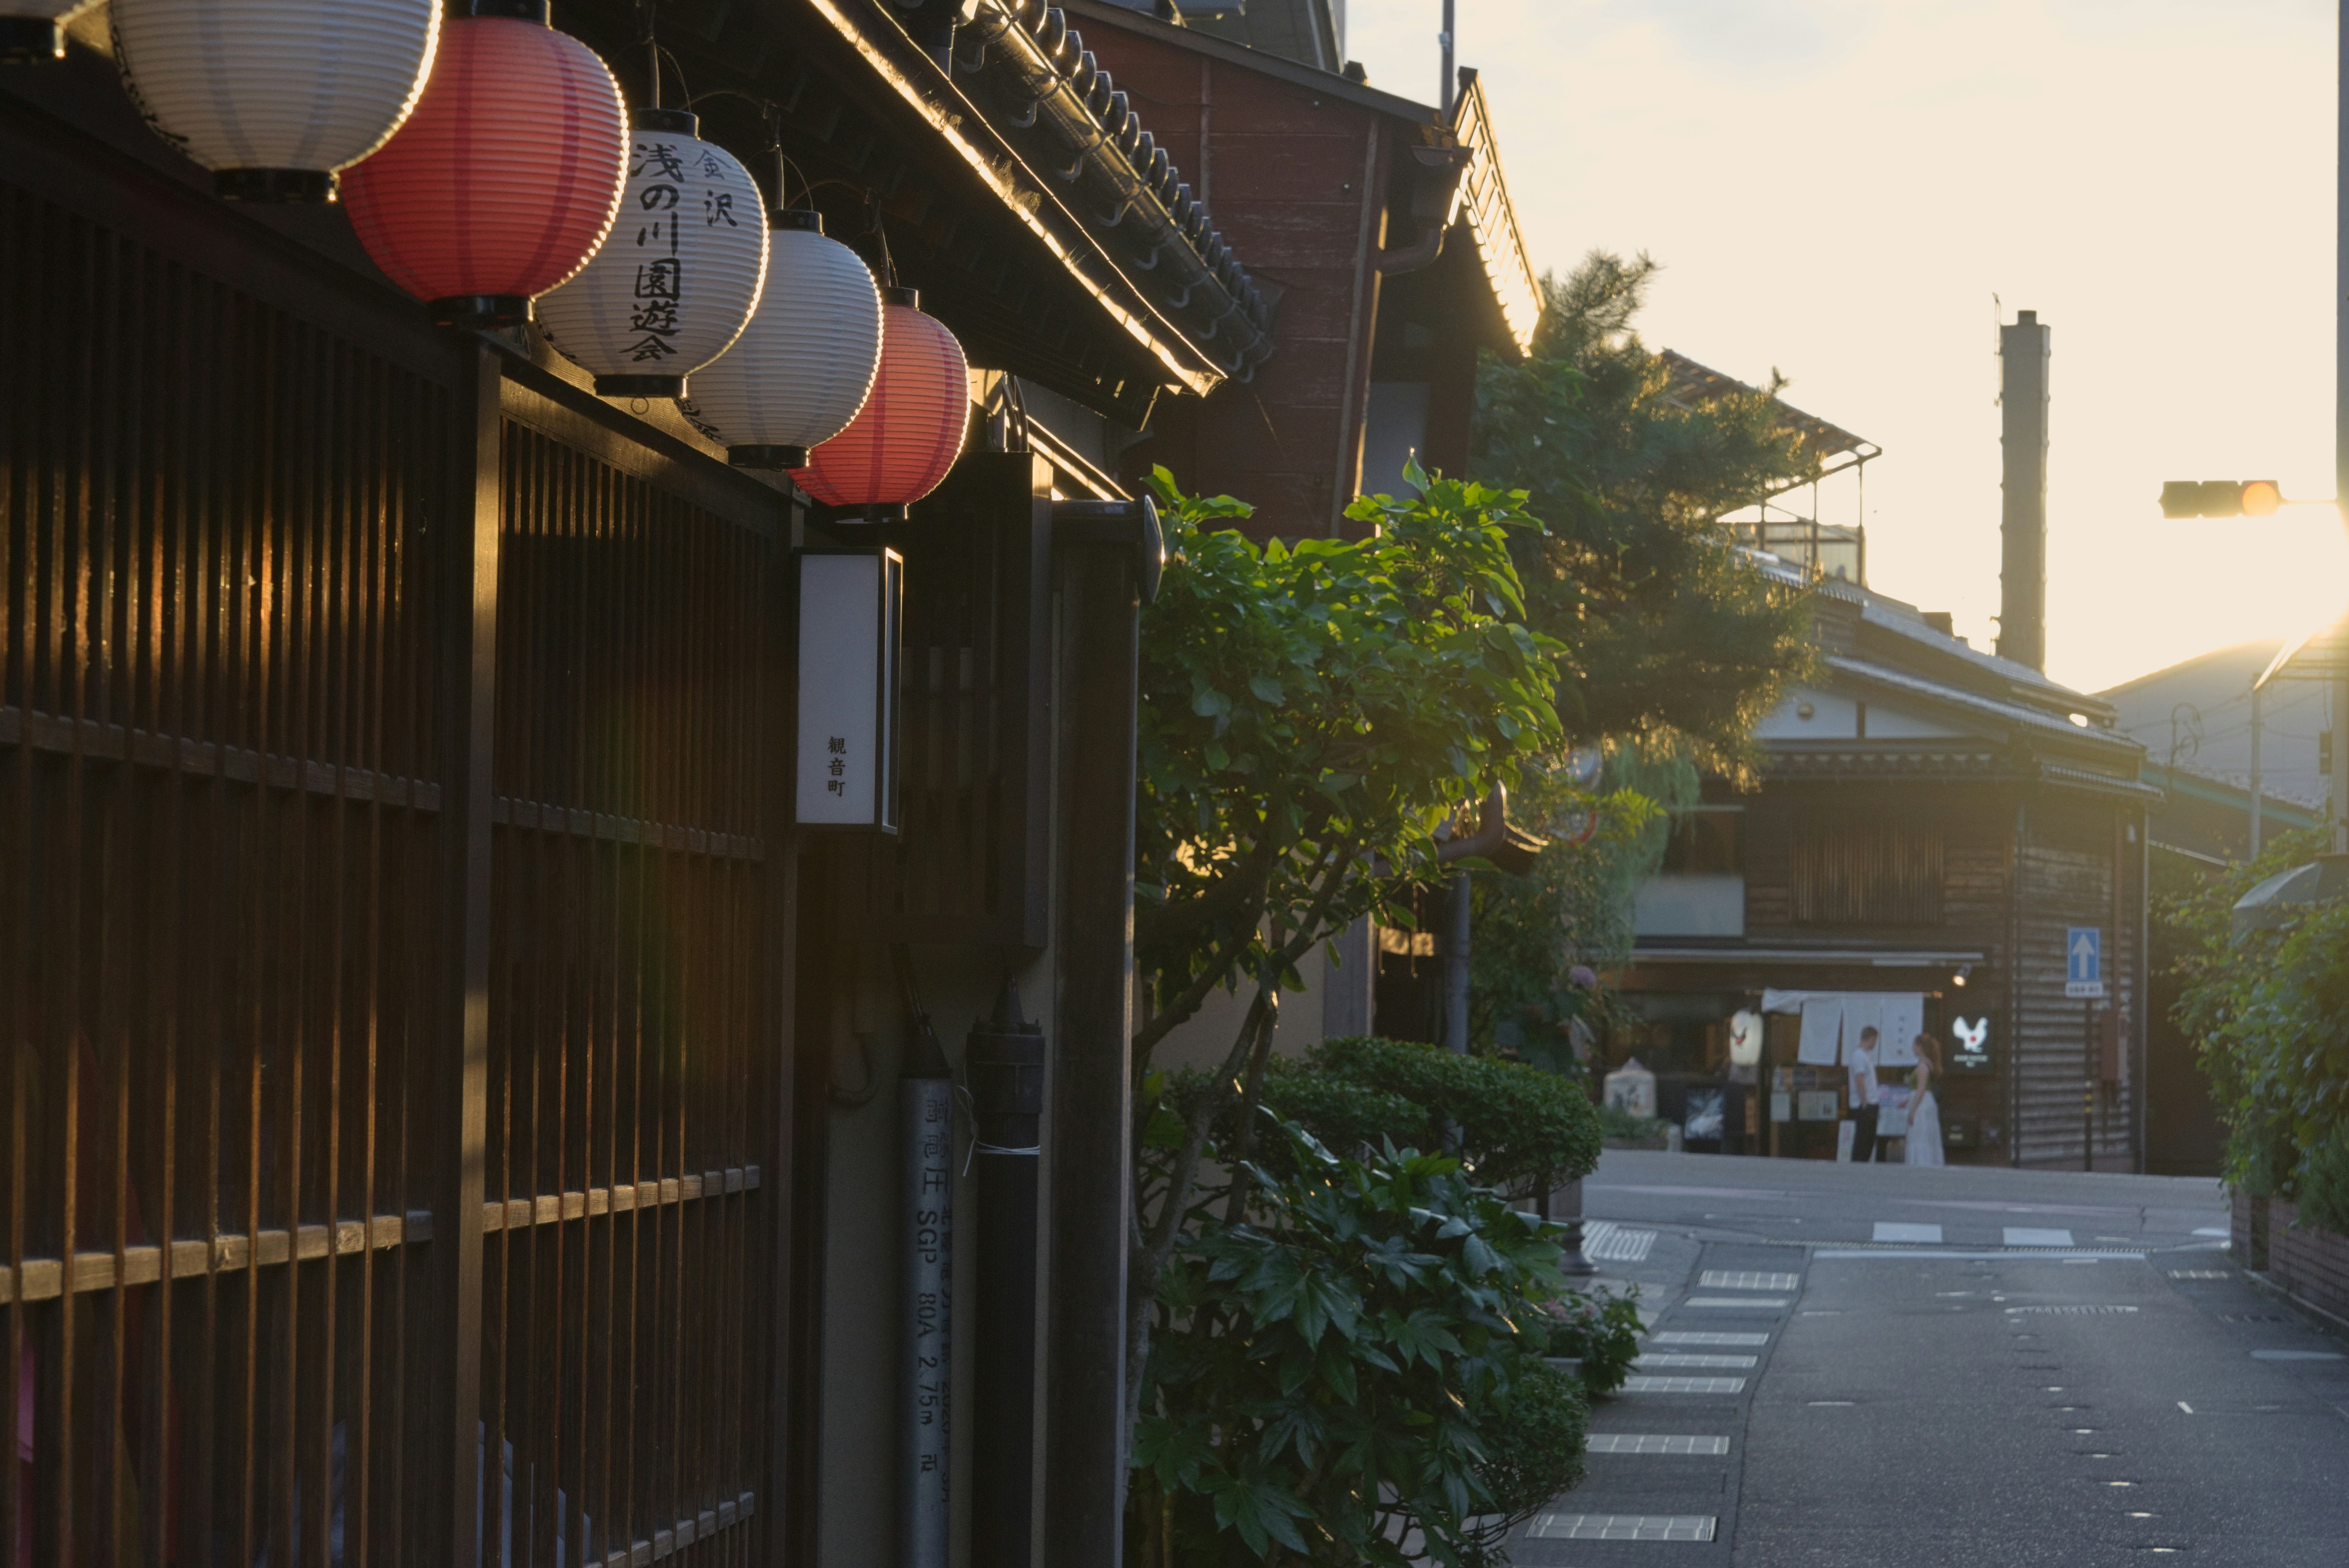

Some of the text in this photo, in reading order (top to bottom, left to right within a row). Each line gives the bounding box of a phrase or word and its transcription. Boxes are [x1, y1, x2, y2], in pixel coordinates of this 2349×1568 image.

[693, 149, 738, 226] 金沢
[618, 143, 684, 362] 浅の川園遊会
[827, 736, 847, 797] 観音町
[917, 1210, 936, 1263] SGP
[918, 1293, 936, 1337] 80A
